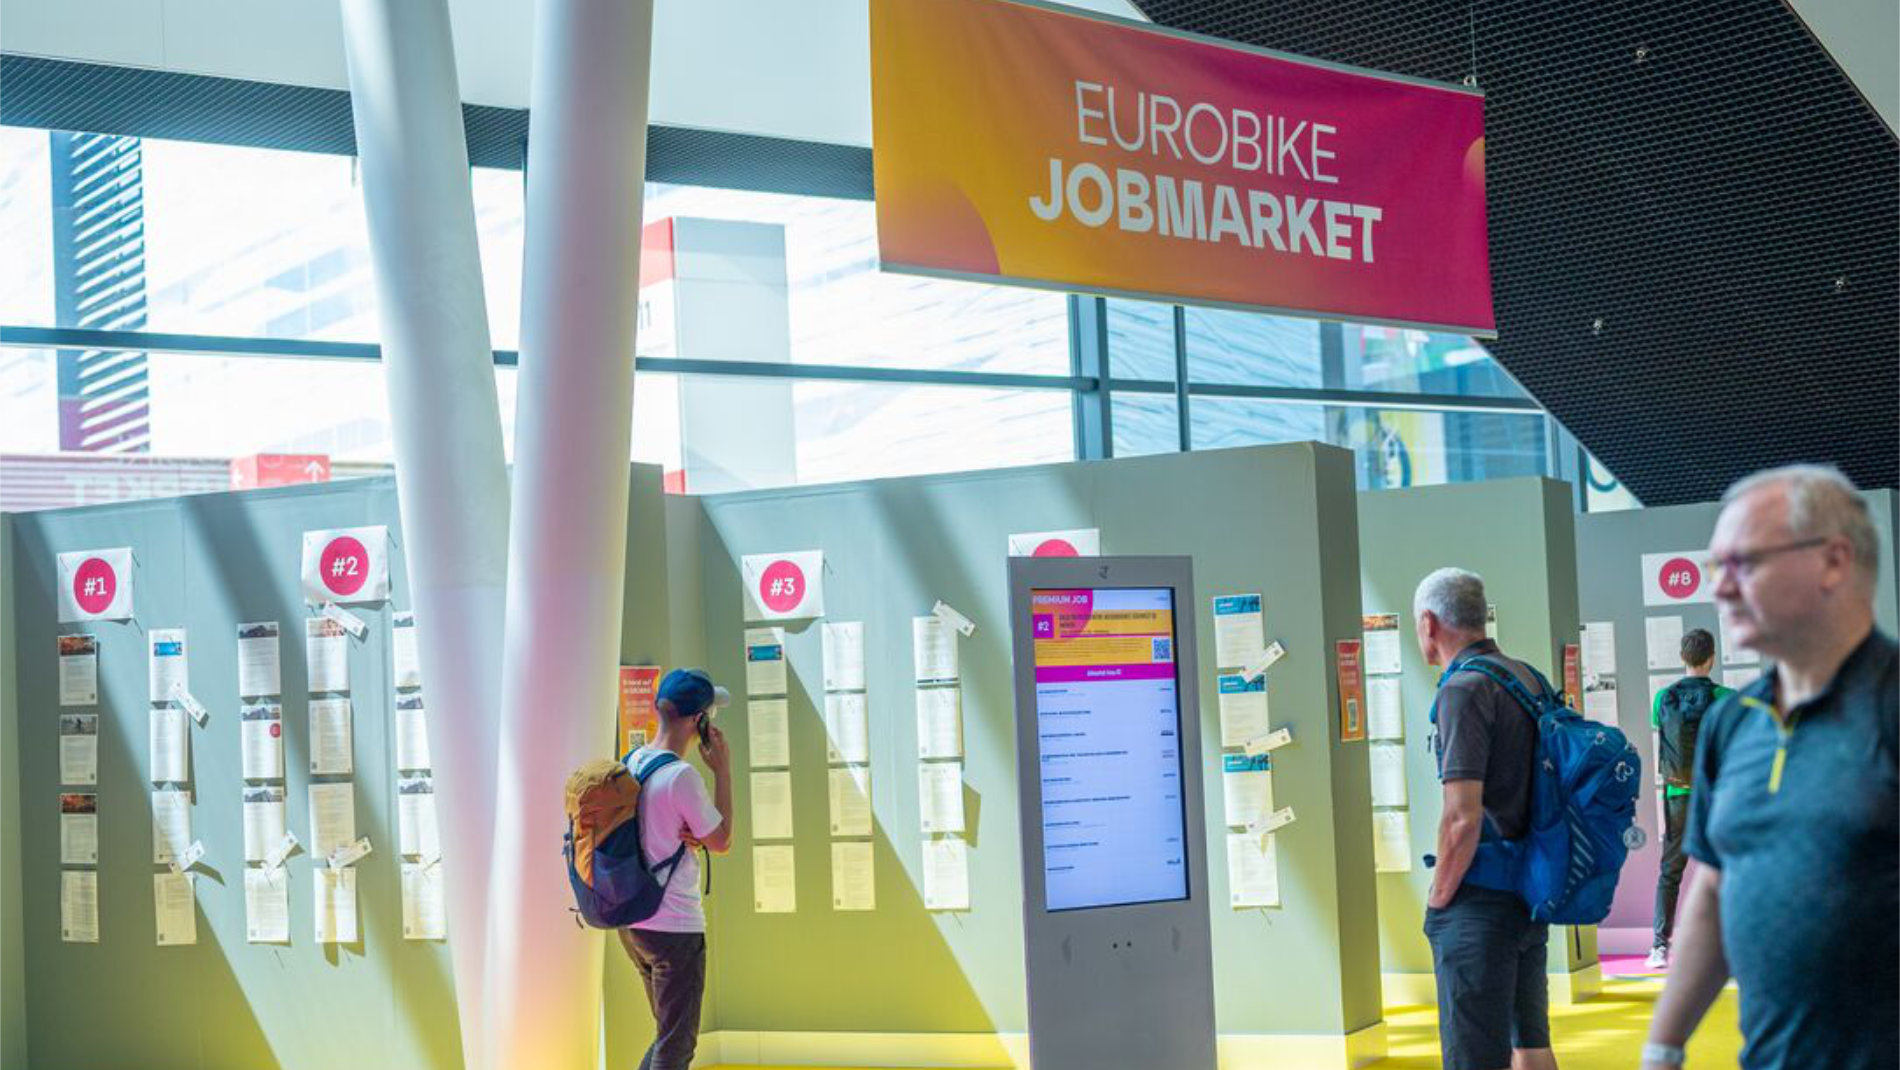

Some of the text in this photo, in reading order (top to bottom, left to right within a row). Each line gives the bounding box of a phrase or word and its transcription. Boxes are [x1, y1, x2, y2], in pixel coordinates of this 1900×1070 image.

[1075, 80, 1339, 184] EUROBIKE
[1029, 158, 1382, 263] JOBMARKET
[331, 555, 359, 577] #2
[84, 577, 107, 597] #1
[769, 576, 796, 597] #3
[1667, 571, 1692, 587] #8
[1072, 594, 1088, 604] JOB
[1037, 621, 1049, 631] #2
